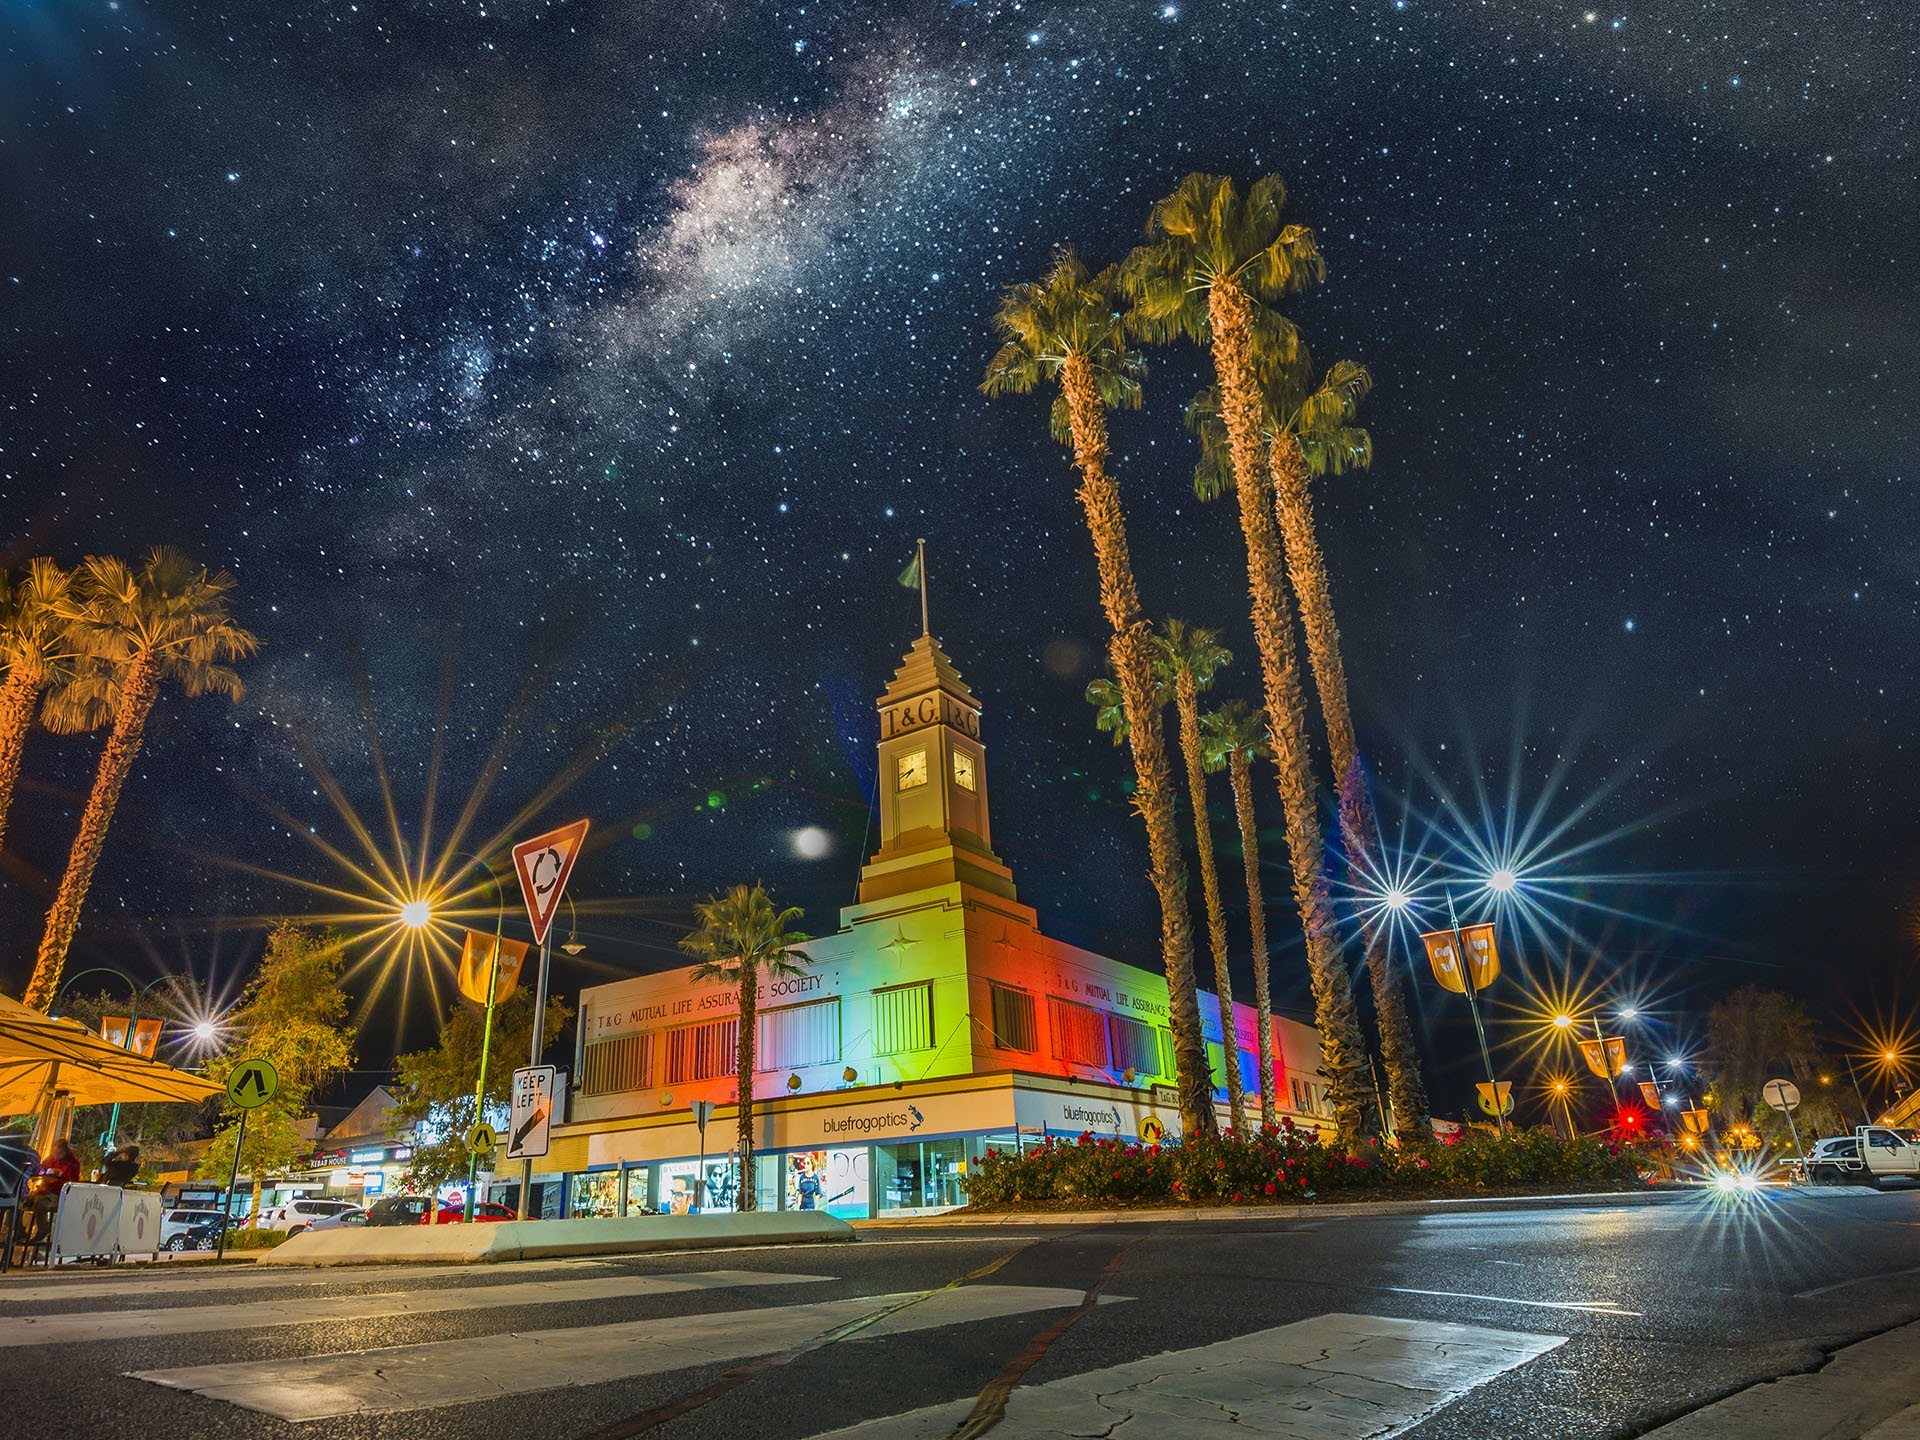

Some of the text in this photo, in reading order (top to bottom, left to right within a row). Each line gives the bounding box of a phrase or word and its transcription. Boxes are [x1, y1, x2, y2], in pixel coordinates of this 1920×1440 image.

[629, 1005, 668, 1024] MUTUAL
[672, 1000, 693, 1016] LIFE
[697, 985, 765, 1011] ASSURAE
[771, 974, 824, 998] SOCIETY
[1085, 983, 1112, 1002] MUTUAL
[1115, 992, 1130, 1008] LIFE
[1132, 997, 1168, 1018] ASSURANCE
[516, 1075, 546, 1091] KEEP
[516, 1093, 543, 1109] LEFT
[823, 1112, 908, 1133] bluefrogoptics
[1063, 1104, 1114, 1126] bluefrogoptics
[310, 1158, 328, 1168] KEBAB
[328, 1157, 347, 1166] HOUSE
